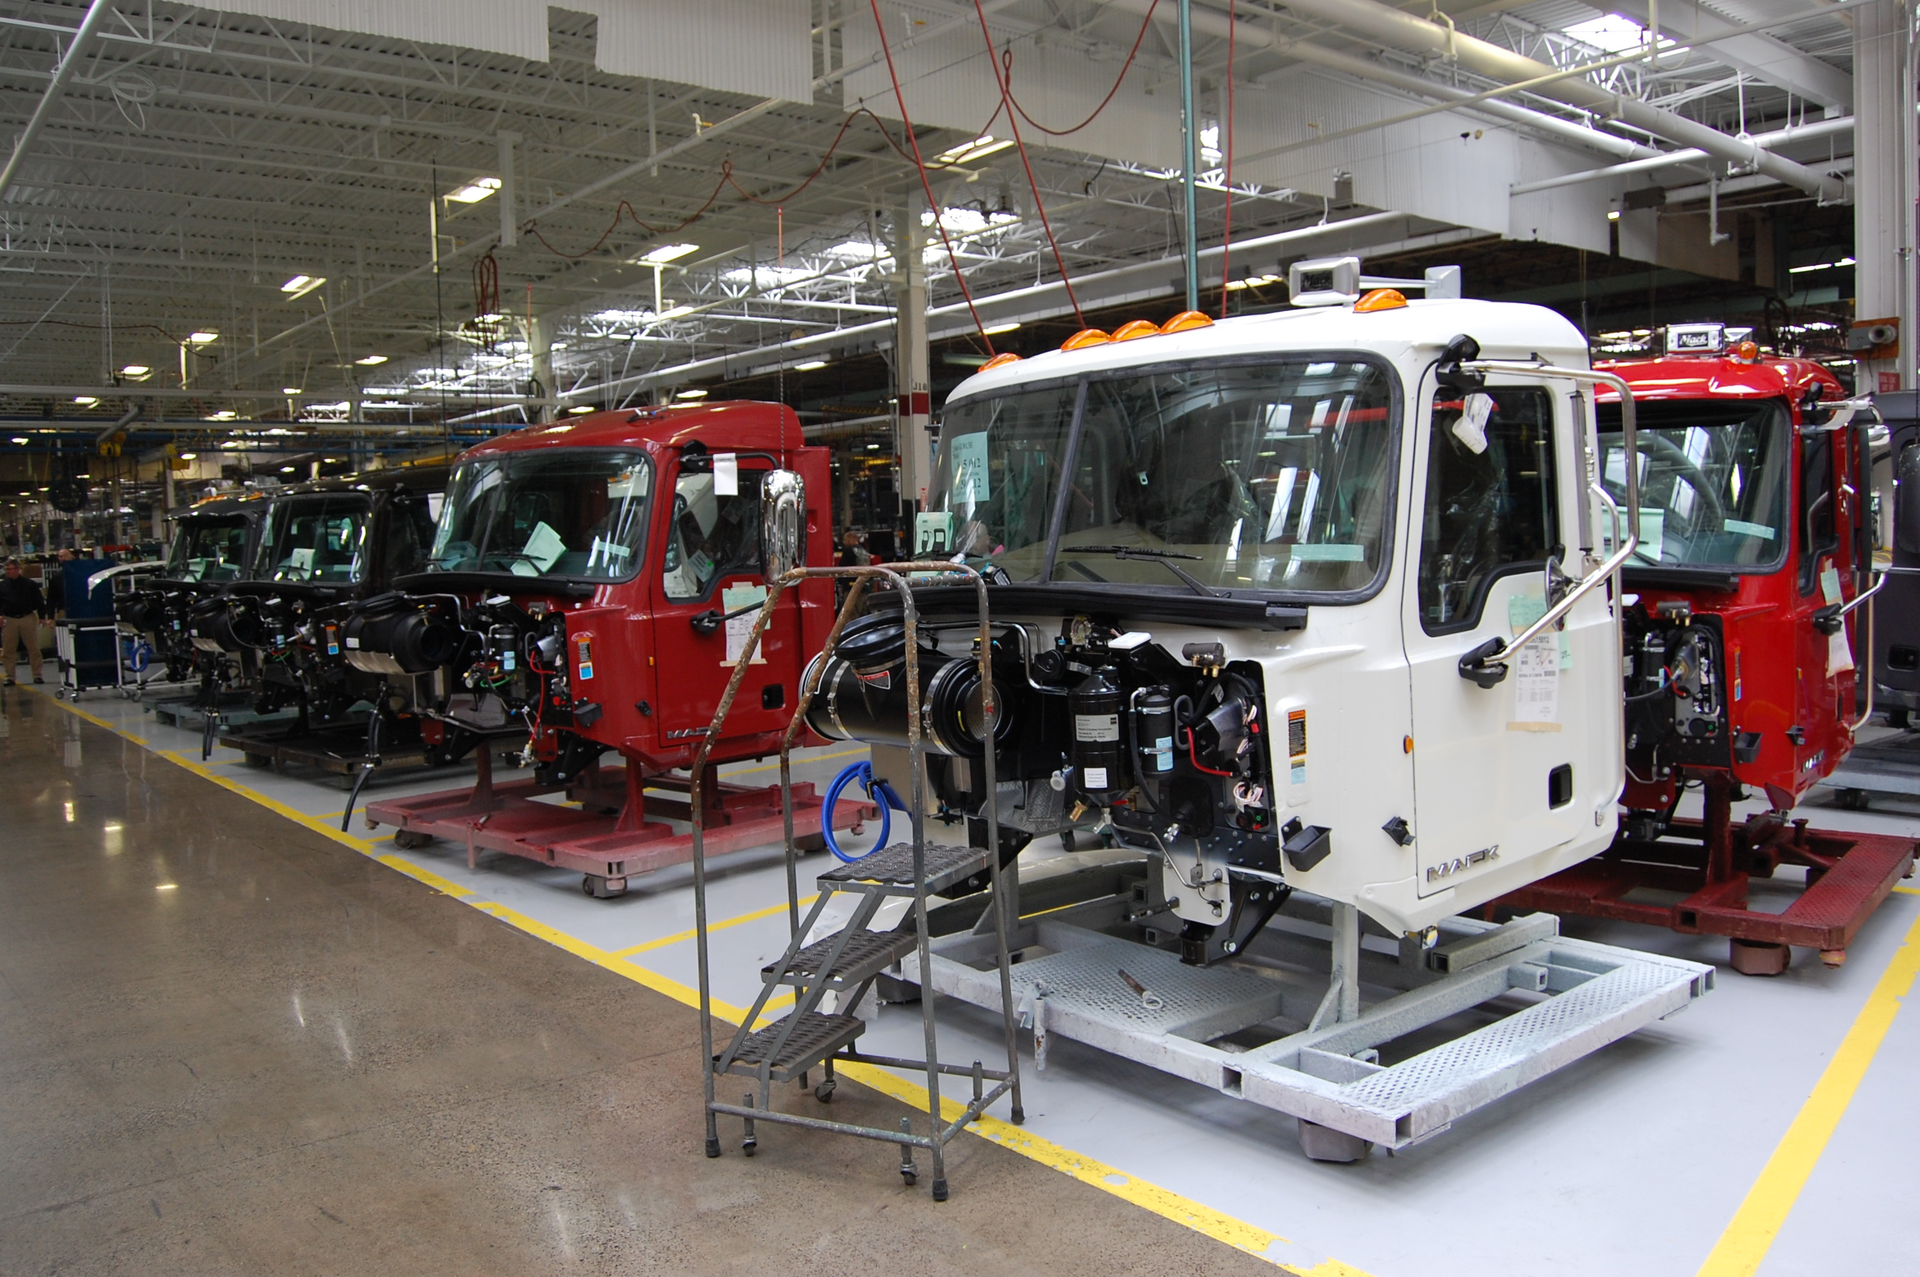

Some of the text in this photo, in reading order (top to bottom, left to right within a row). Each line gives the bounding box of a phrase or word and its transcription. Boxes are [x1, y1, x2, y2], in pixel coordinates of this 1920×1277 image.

[1302, 272, 1332, 289] Mack
[1679, 333, 1708, 347] Mack
[666, 726, 722, 739] MAC
[1427, 844, 1501, 882] MACK
